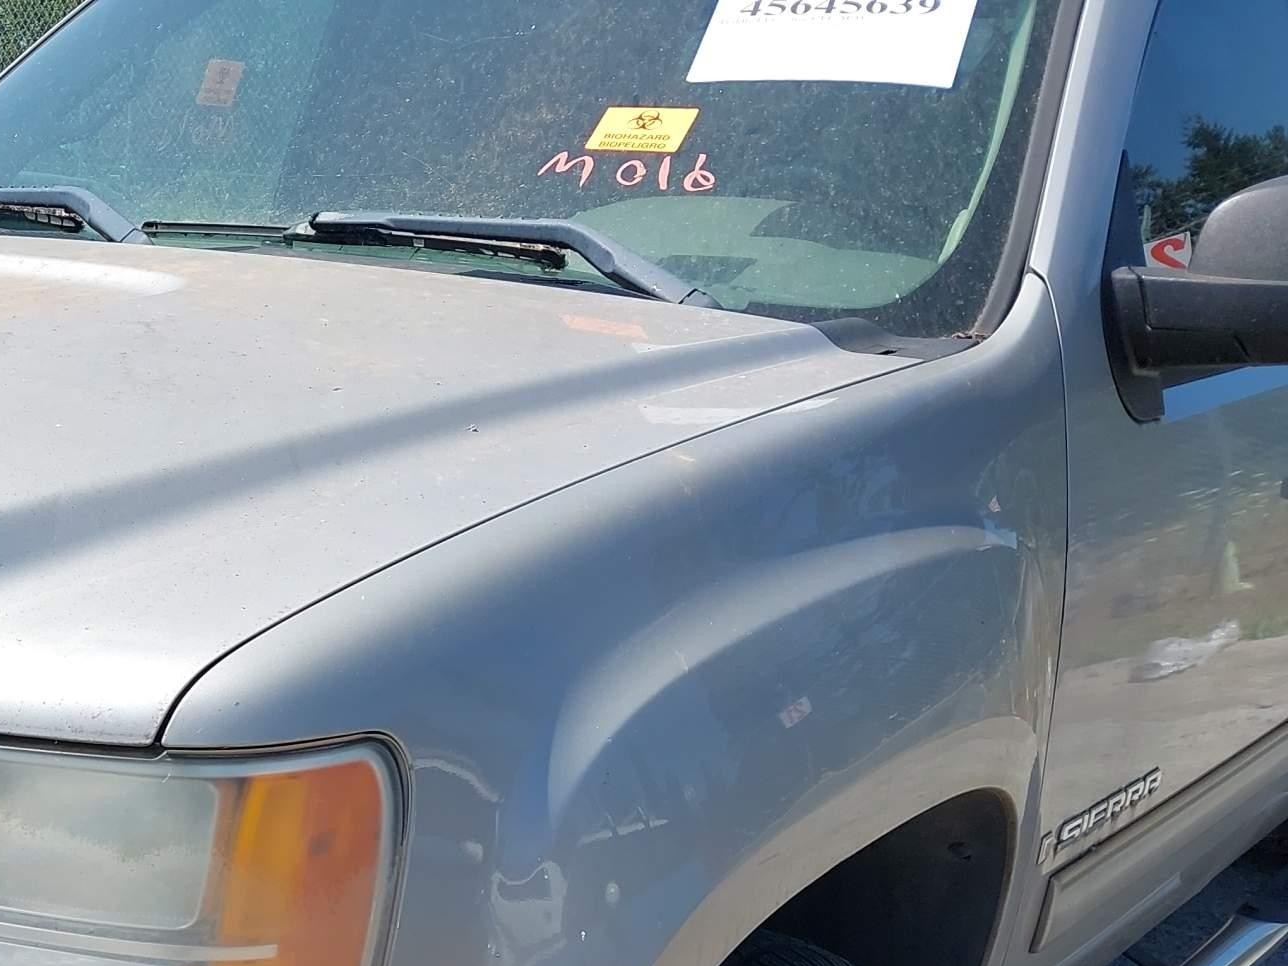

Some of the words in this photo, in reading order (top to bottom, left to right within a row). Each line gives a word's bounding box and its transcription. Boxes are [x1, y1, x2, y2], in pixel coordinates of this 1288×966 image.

[603, 133, 671, 141] BIOHAZARD
[598, 141, 667, 149] BIOPELIGRO
[1058, 766, 1162, 843] SIERRA
